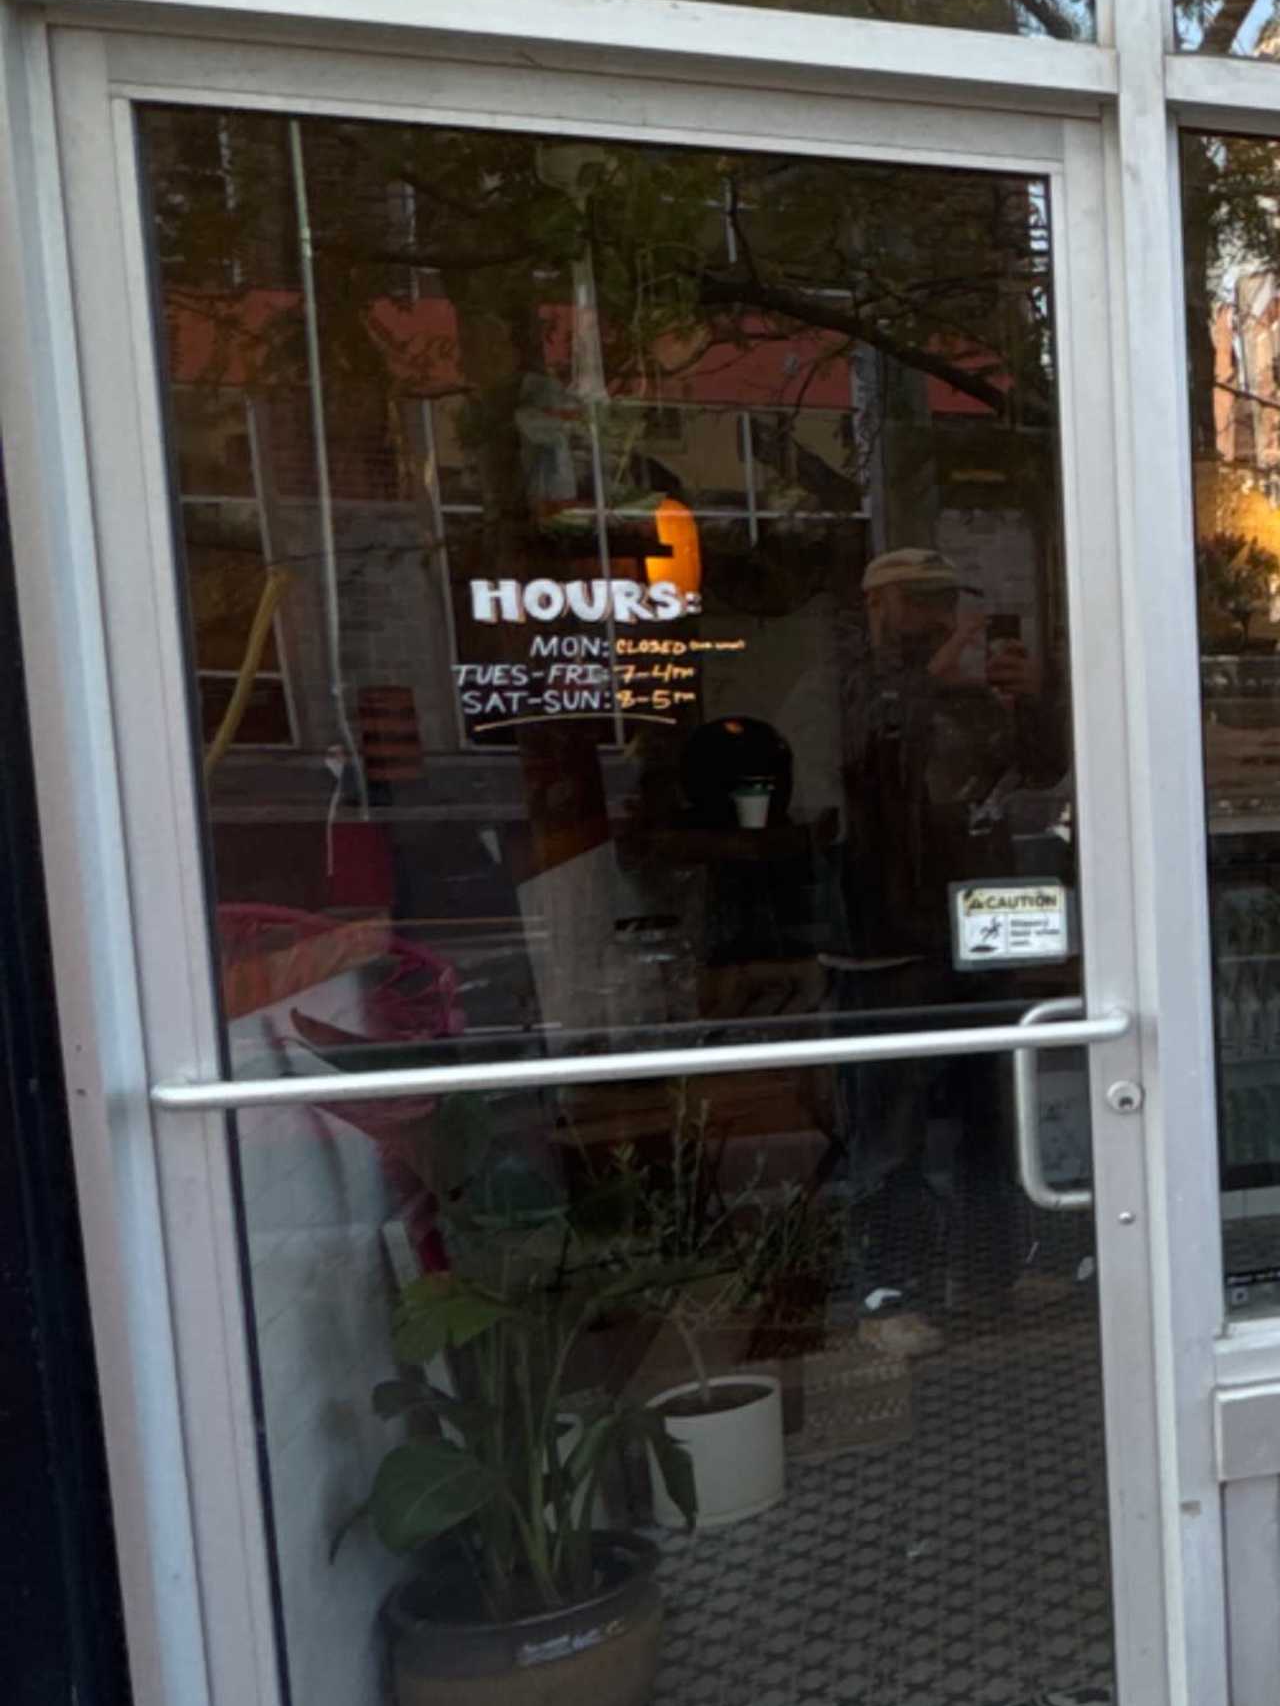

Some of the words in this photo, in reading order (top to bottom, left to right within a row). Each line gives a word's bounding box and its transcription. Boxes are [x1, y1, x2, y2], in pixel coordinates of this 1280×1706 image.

[469, 577, 703, 625] HOURS:
[529, 634, 610, 659] MON:
[615, 638, 688, 656] CLOSED
[461, 689, 612, 715] SAT-SUN:
[986, 892, 1057, 910] CAUTION
